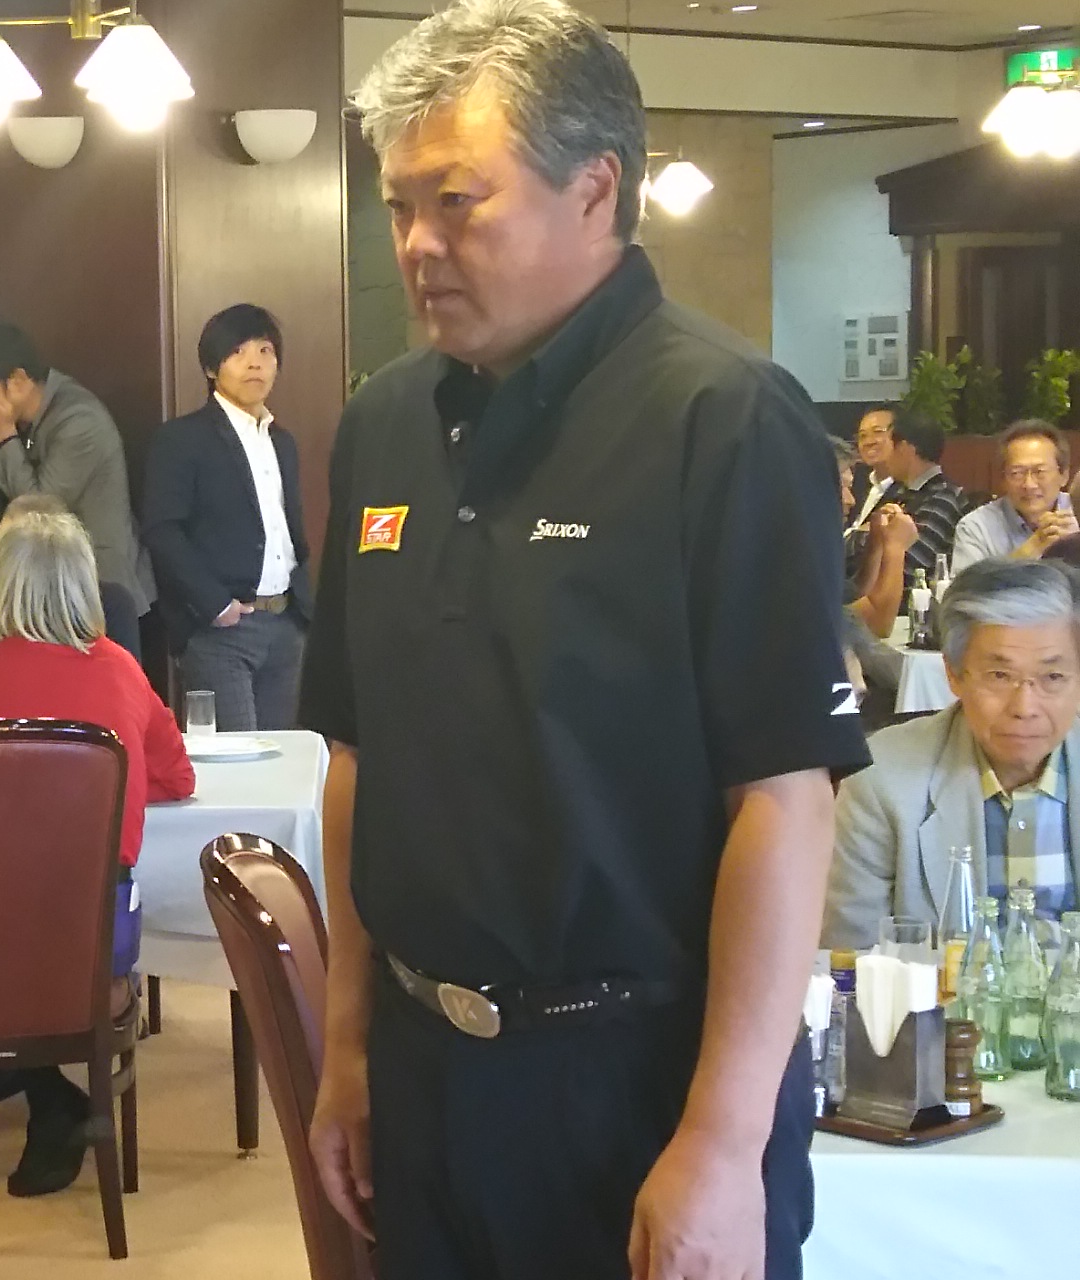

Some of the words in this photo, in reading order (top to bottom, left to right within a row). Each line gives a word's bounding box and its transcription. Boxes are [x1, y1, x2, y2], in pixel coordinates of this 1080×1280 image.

[368, 514, 396, 533] Z
[529, 518, 591, 541] SRIXON
[366, 533, 392, 544] STAR
